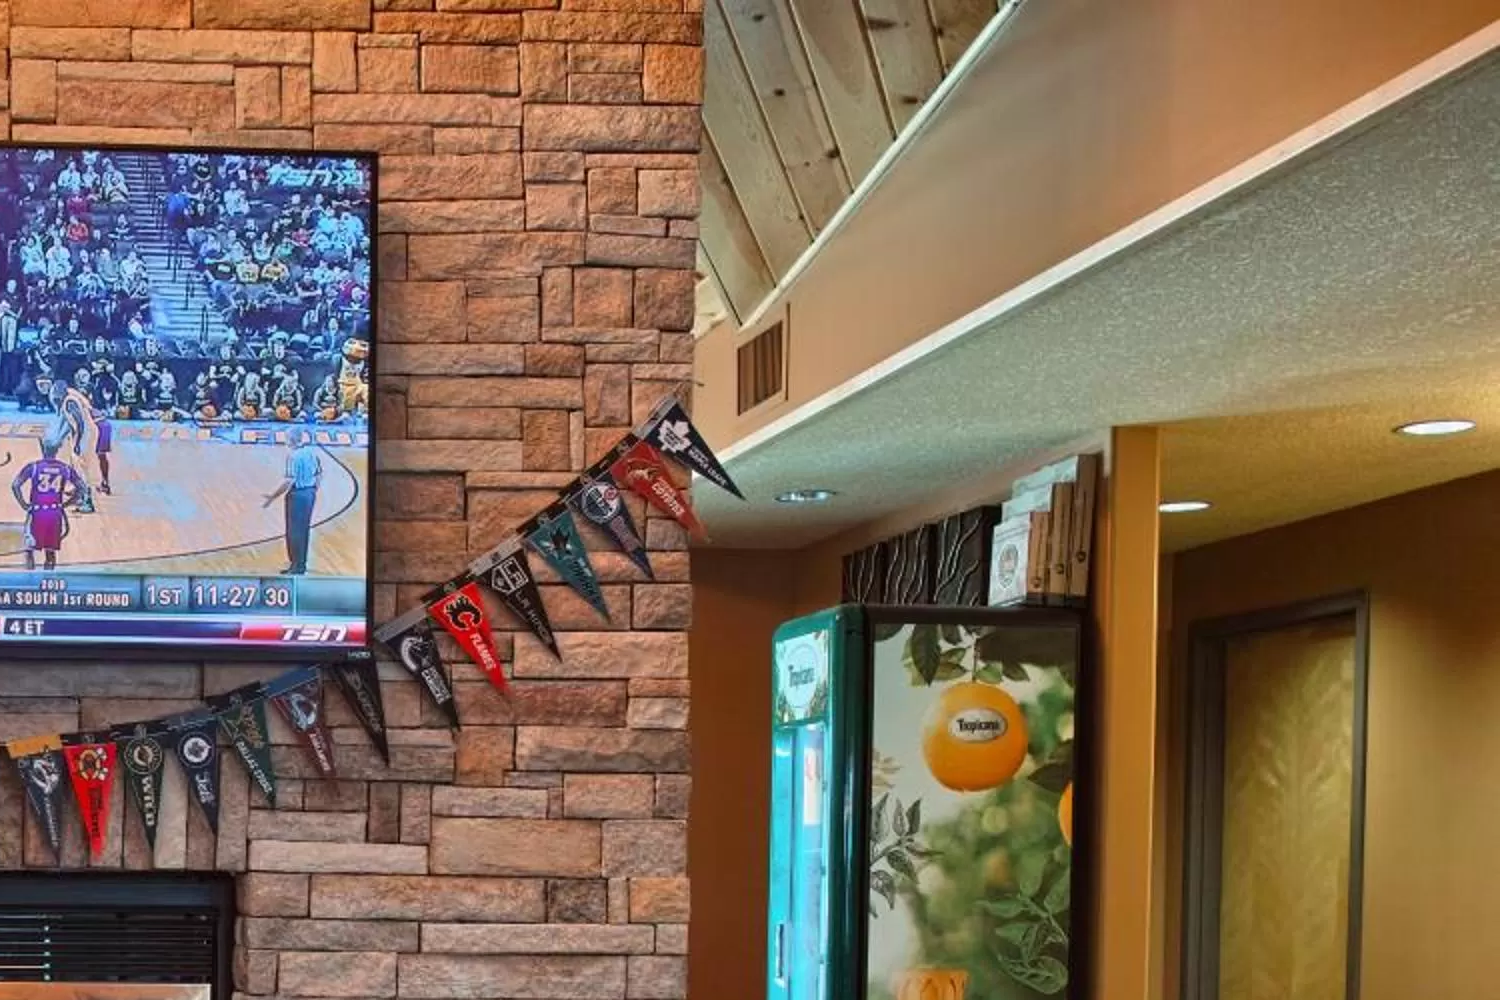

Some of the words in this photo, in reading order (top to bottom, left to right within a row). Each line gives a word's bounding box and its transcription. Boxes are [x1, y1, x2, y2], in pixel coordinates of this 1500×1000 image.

[37, 473, 63, 494] 34
[15, 591, 57, 606] SOUTH
[86, 592, 130, 607] ROUND
[147, 585, 183, 606] 1ST
[194, 585, 256, 607] 11:27
[265, 587, 289, 606] 30
[9, 620, 21, 634] 4
[24, 620, 45, 635] ET
[469, 630, 497, 671] FLAMES
